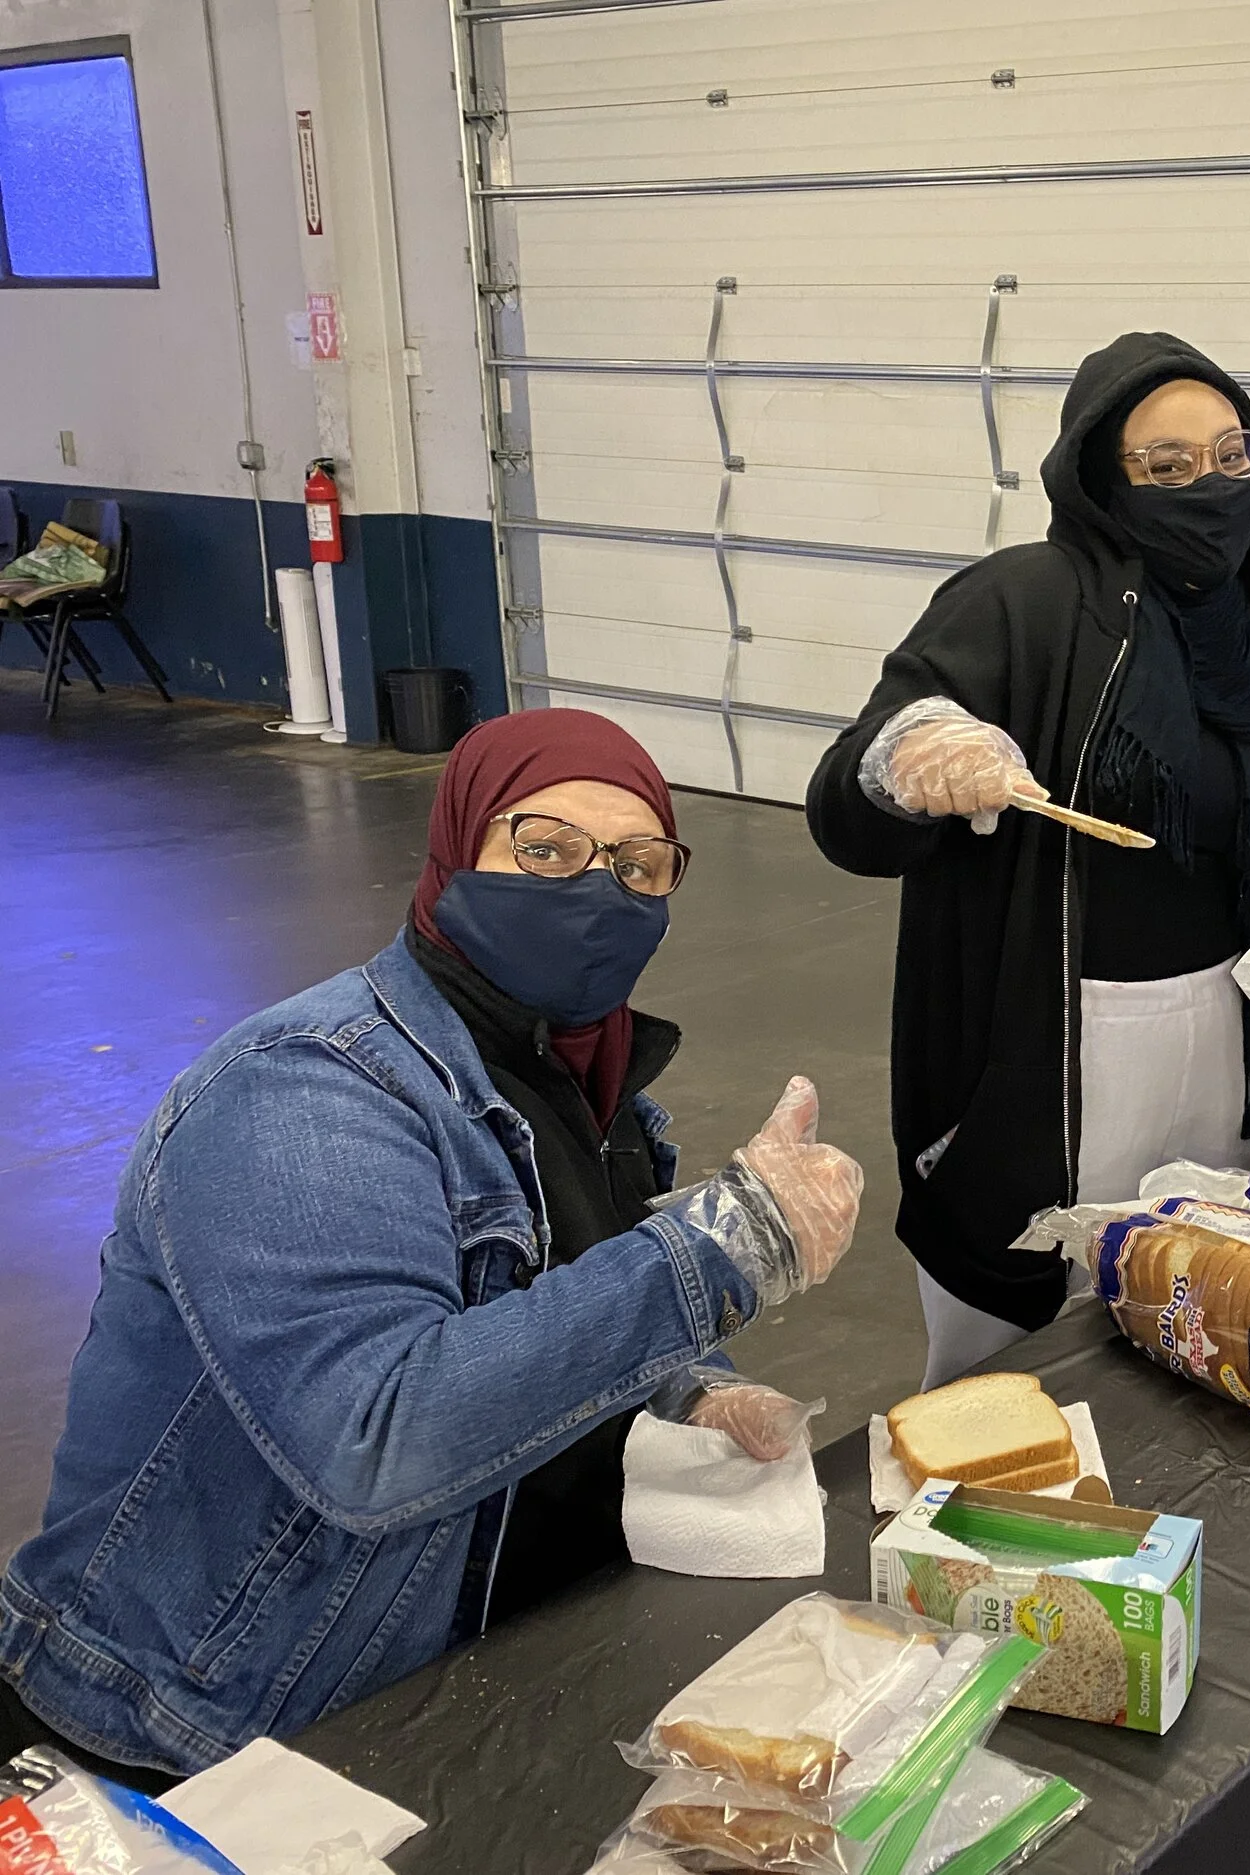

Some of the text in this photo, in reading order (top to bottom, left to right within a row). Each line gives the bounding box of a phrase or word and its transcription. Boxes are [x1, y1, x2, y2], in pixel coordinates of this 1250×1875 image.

[1159, 1273, 1190, 1350] BAIRD'S
[981, 1597, 999, 1632] ble
[1002, 1599, 1013, 1623] Bags
[1123, 1592, 1143, 1630] 100
[1144, 1600, 1155, 1632] BAGS
[1138, 1652, 1151, 1718] Sandwich
